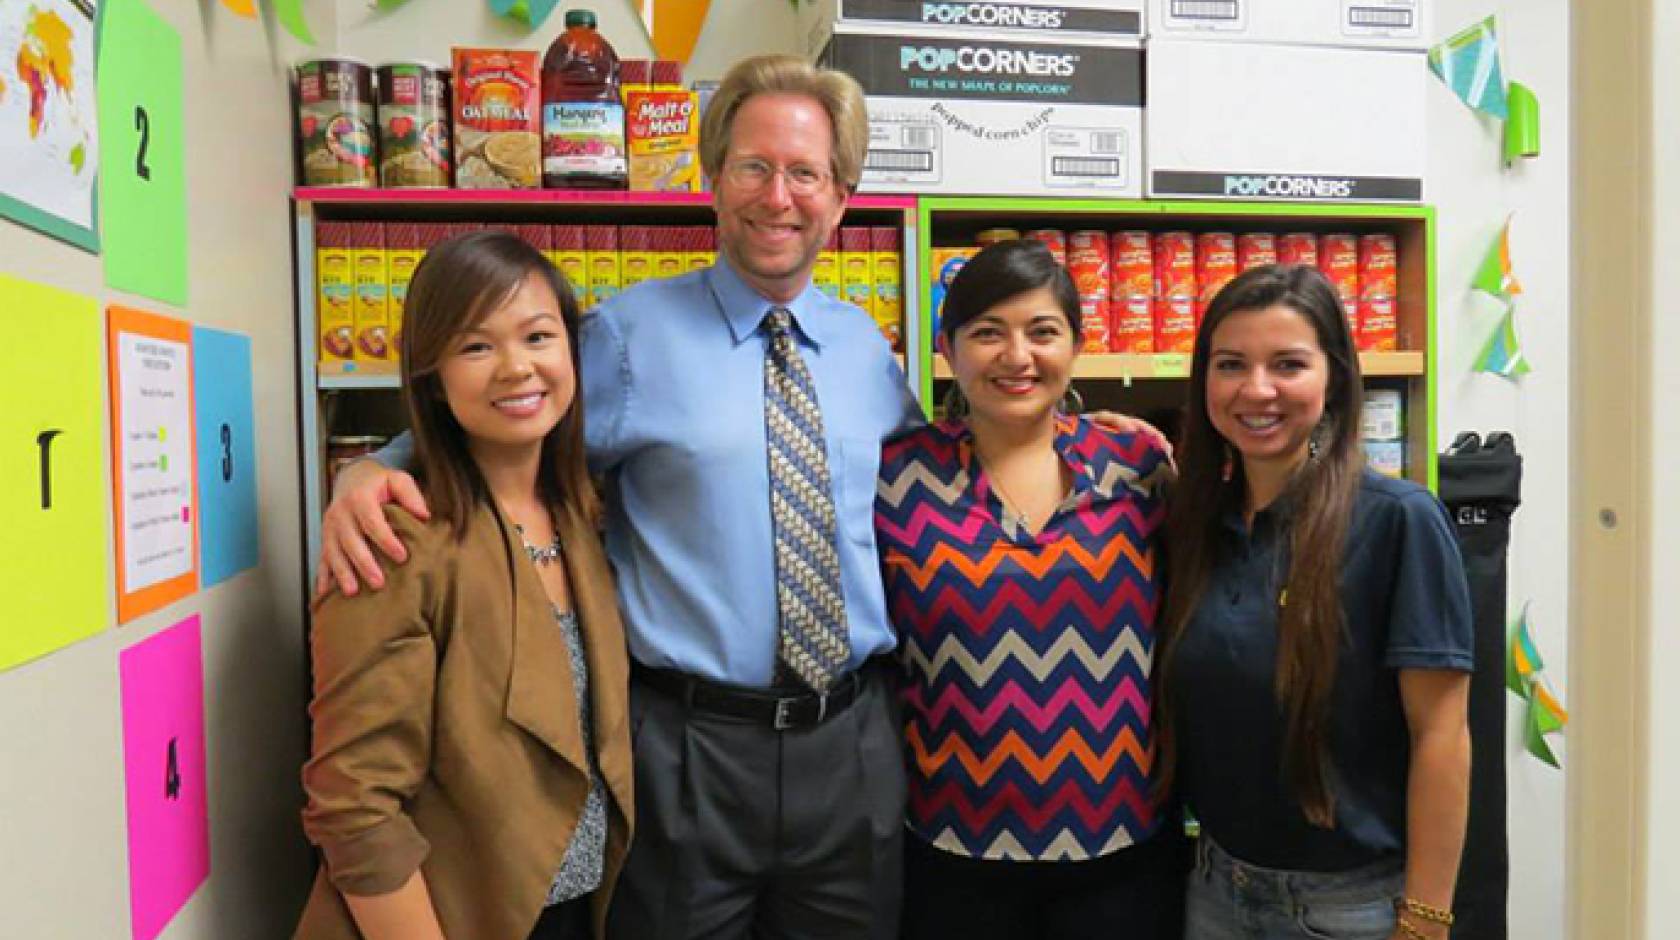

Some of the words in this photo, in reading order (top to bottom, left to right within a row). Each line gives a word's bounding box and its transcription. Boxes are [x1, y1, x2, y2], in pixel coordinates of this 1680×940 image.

[922, 3, 1061, 28] POPCORNERS
[900, 45, 1075, 77] POPCORNERS
[135, 104, 150, 181] 2
[1224, 175, 1350, 197] POPCORNERS
[36, 429, 64, 510] 1
[220, 422, 233, 484] 3
[165, 736, 181, 801] 4
